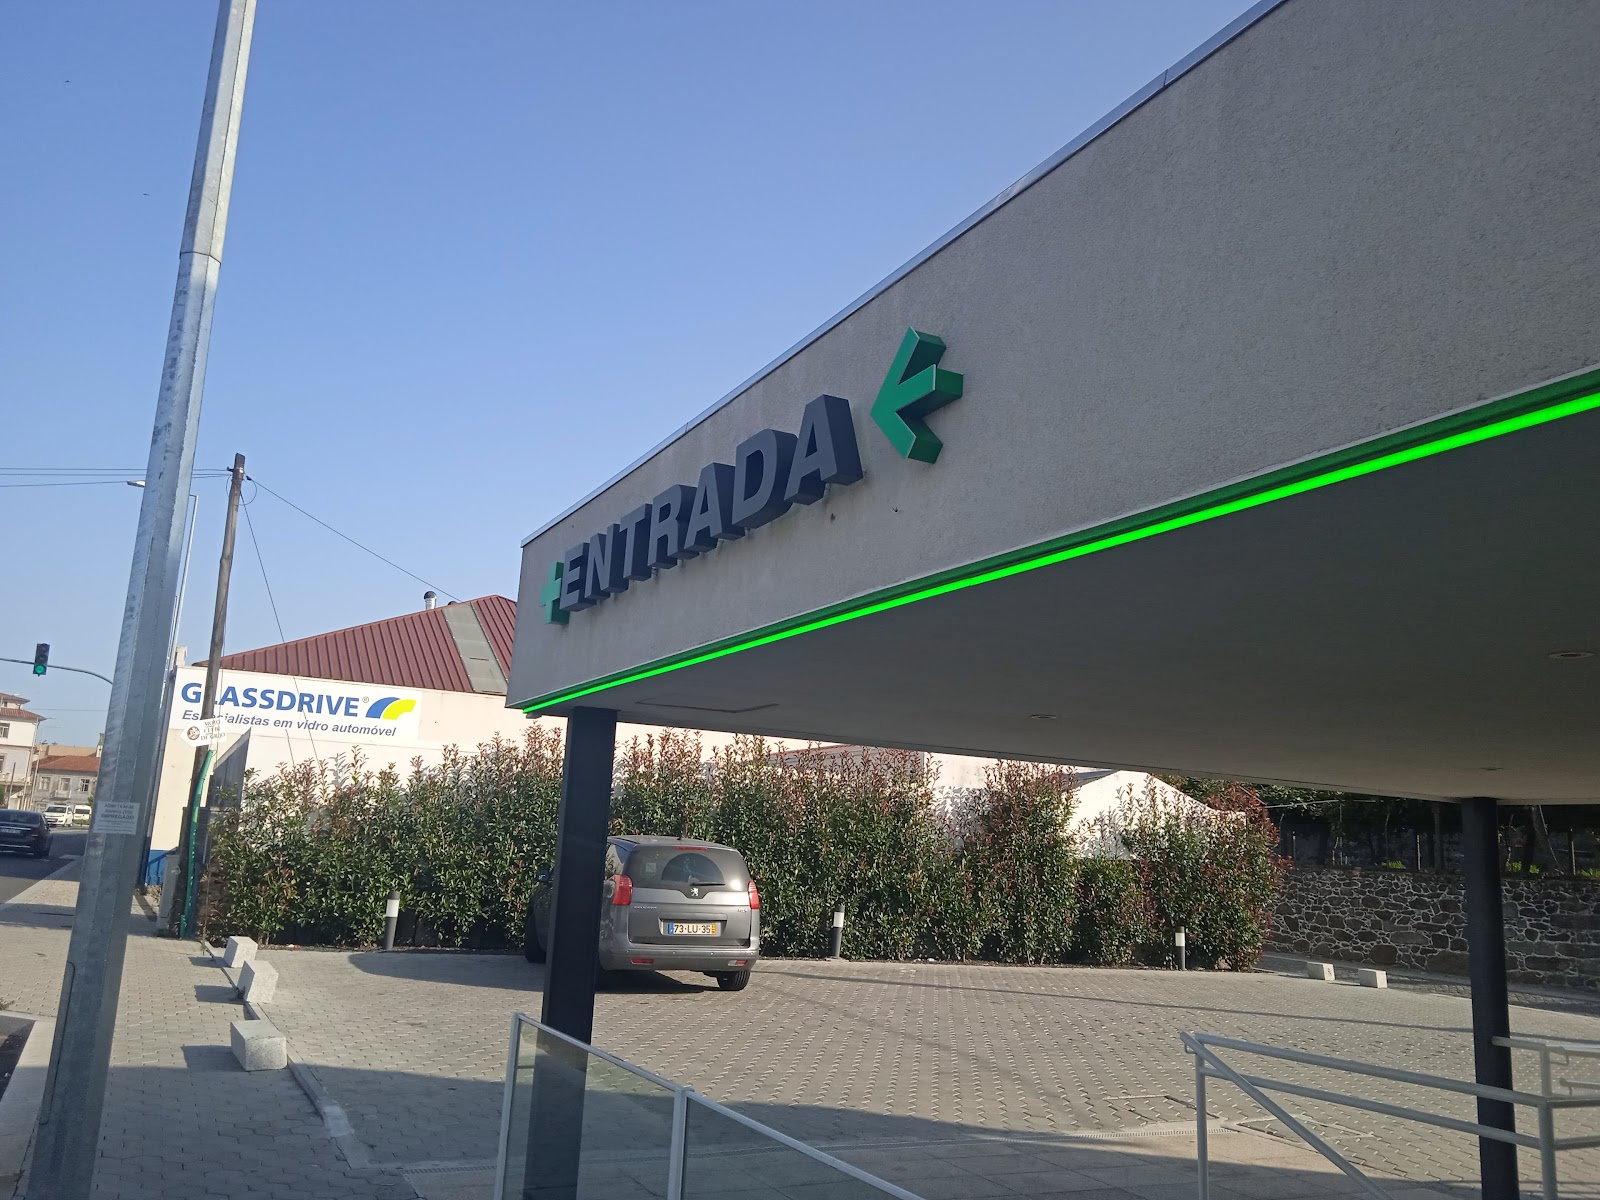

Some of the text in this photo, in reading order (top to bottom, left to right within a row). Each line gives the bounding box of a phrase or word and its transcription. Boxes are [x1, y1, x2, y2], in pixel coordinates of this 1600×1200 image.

[559, 394, 864, 612] ENTRADA
[181, 682, 360, 717] GASSDRIVE
[273, 719, 293, 728] em
[297, 719, 329, 731] vidro
[332, 723, 397, 736] automóvel
